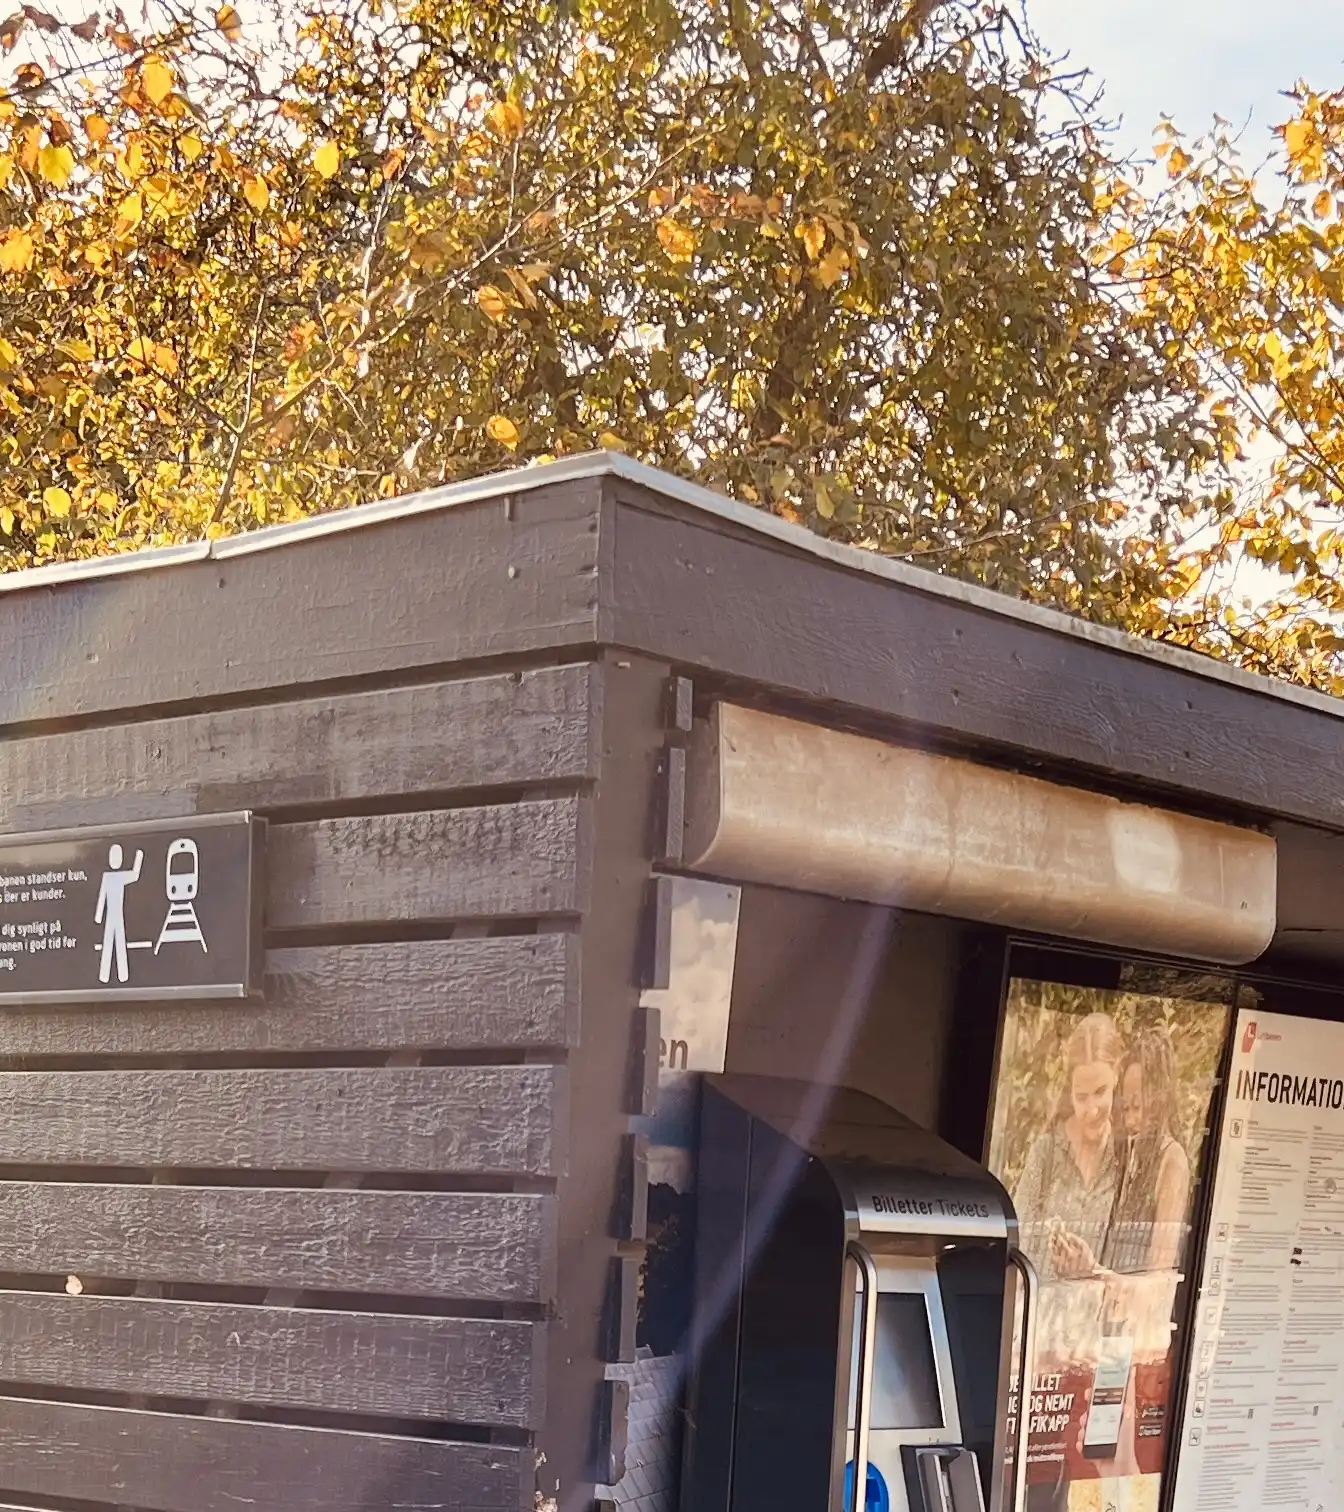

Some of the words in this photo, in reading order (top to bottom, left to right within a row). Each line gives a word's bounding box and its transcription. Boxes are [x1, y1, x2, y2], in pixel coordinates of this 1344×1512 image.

[27, 871, 67, 885] standser
[68, 868, 89, 882] kun,
[4, 889, 19, 903] der
[21, 892, 31, 902] er
[32, 887, 67, 901] kunder.
[2, 923, 16, 938] dig
[17, 921, 49, 937] synligt
[50, 919, 62, 935] på
[30, 937, 47, 954] god
[48, 936, 61, 949] tid
[871, 1196, 933, 1215] Billetter
[935, 1199, 989, 1218] Tickets
[1045, 1393, 1075, 1412] NEMT
